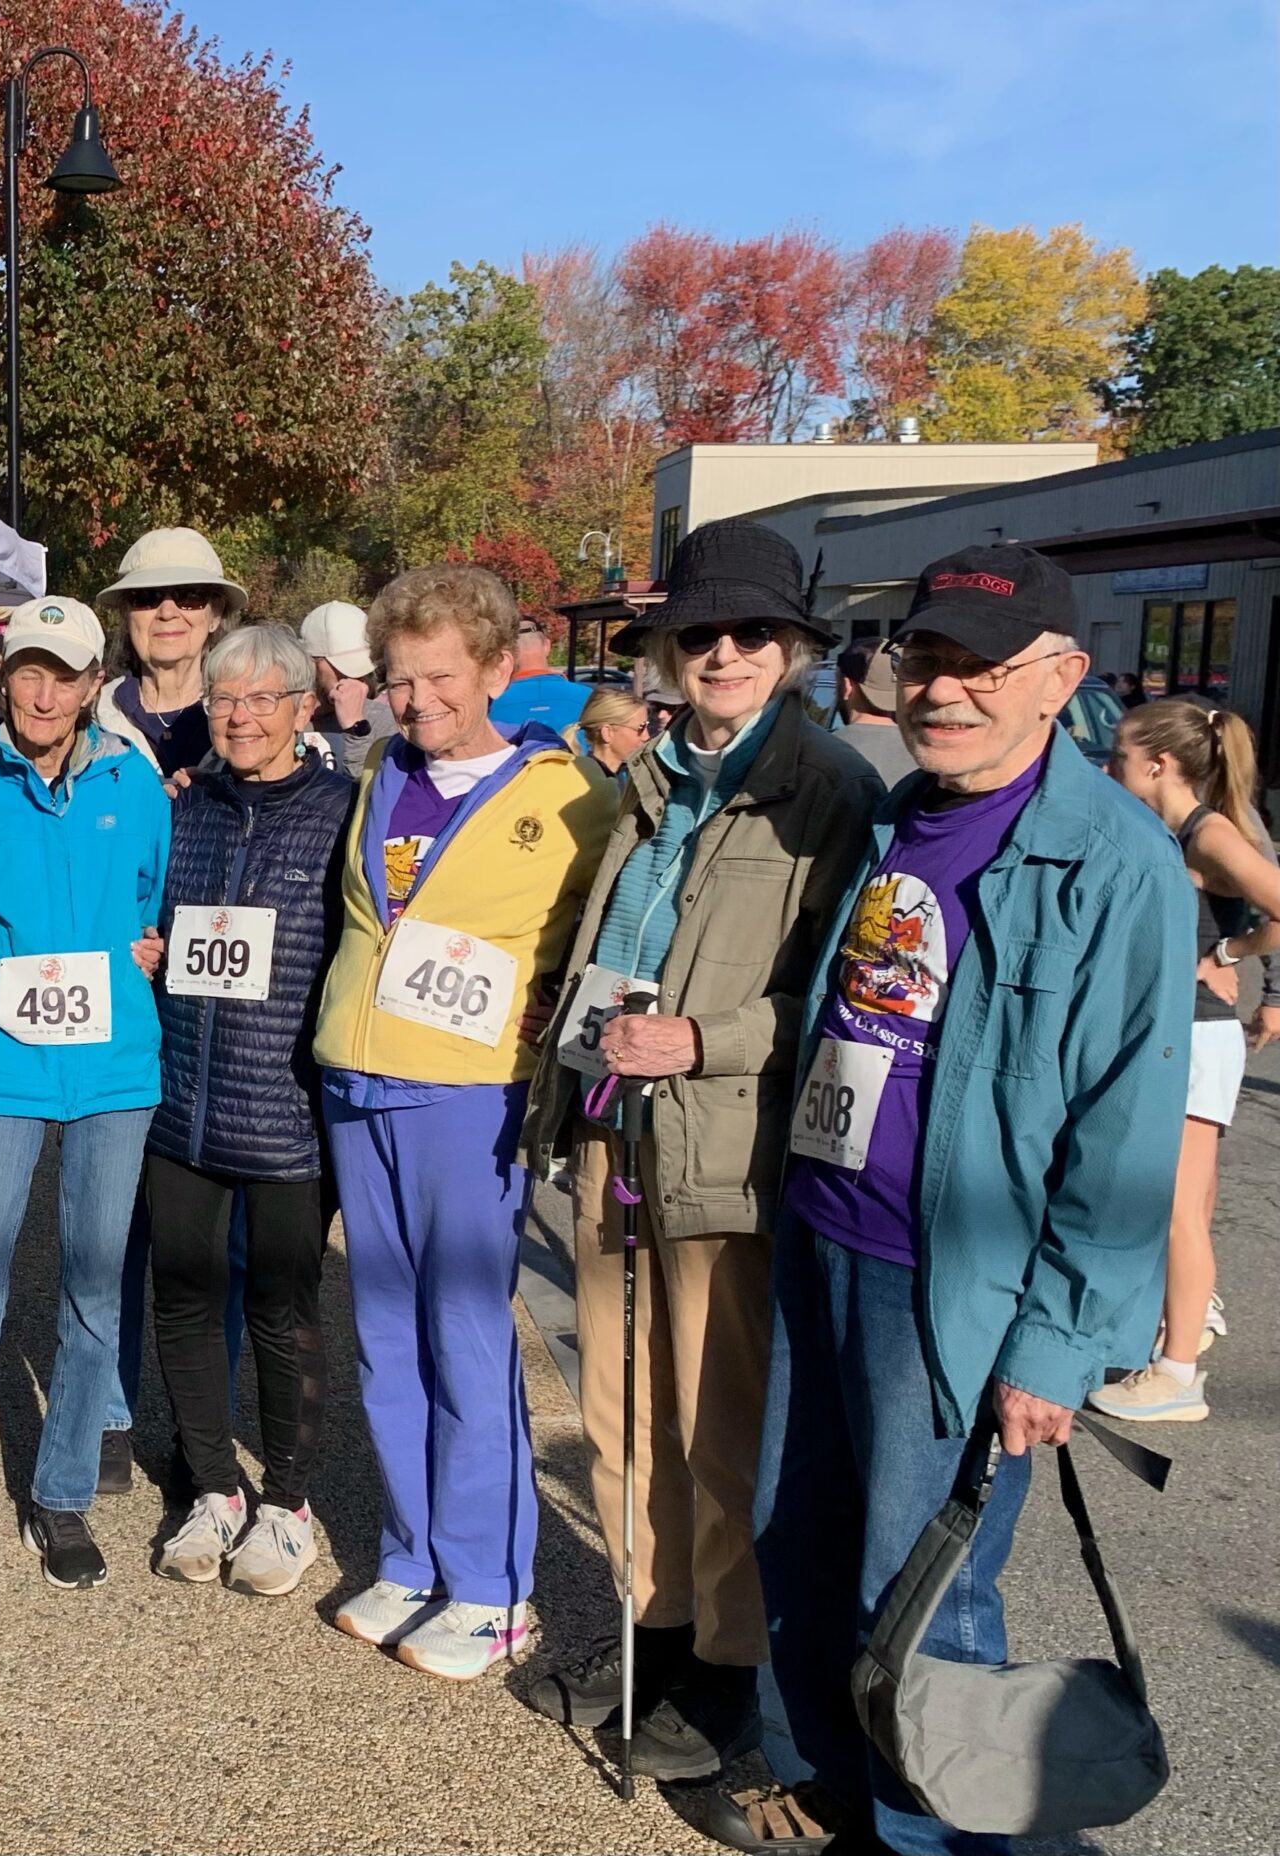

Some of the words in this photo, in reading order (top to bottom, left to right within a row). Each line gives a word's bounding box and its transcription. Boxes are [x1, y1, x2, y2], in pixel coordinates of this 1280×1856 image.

[186, 938, 251, 978] 509
[16, 985, 91, 1025] 493
[404, 959, 492, 1017] 496
[855, 1014, 911, 1050] CLASSIC
[805, 1080, 855, 1138] 508
